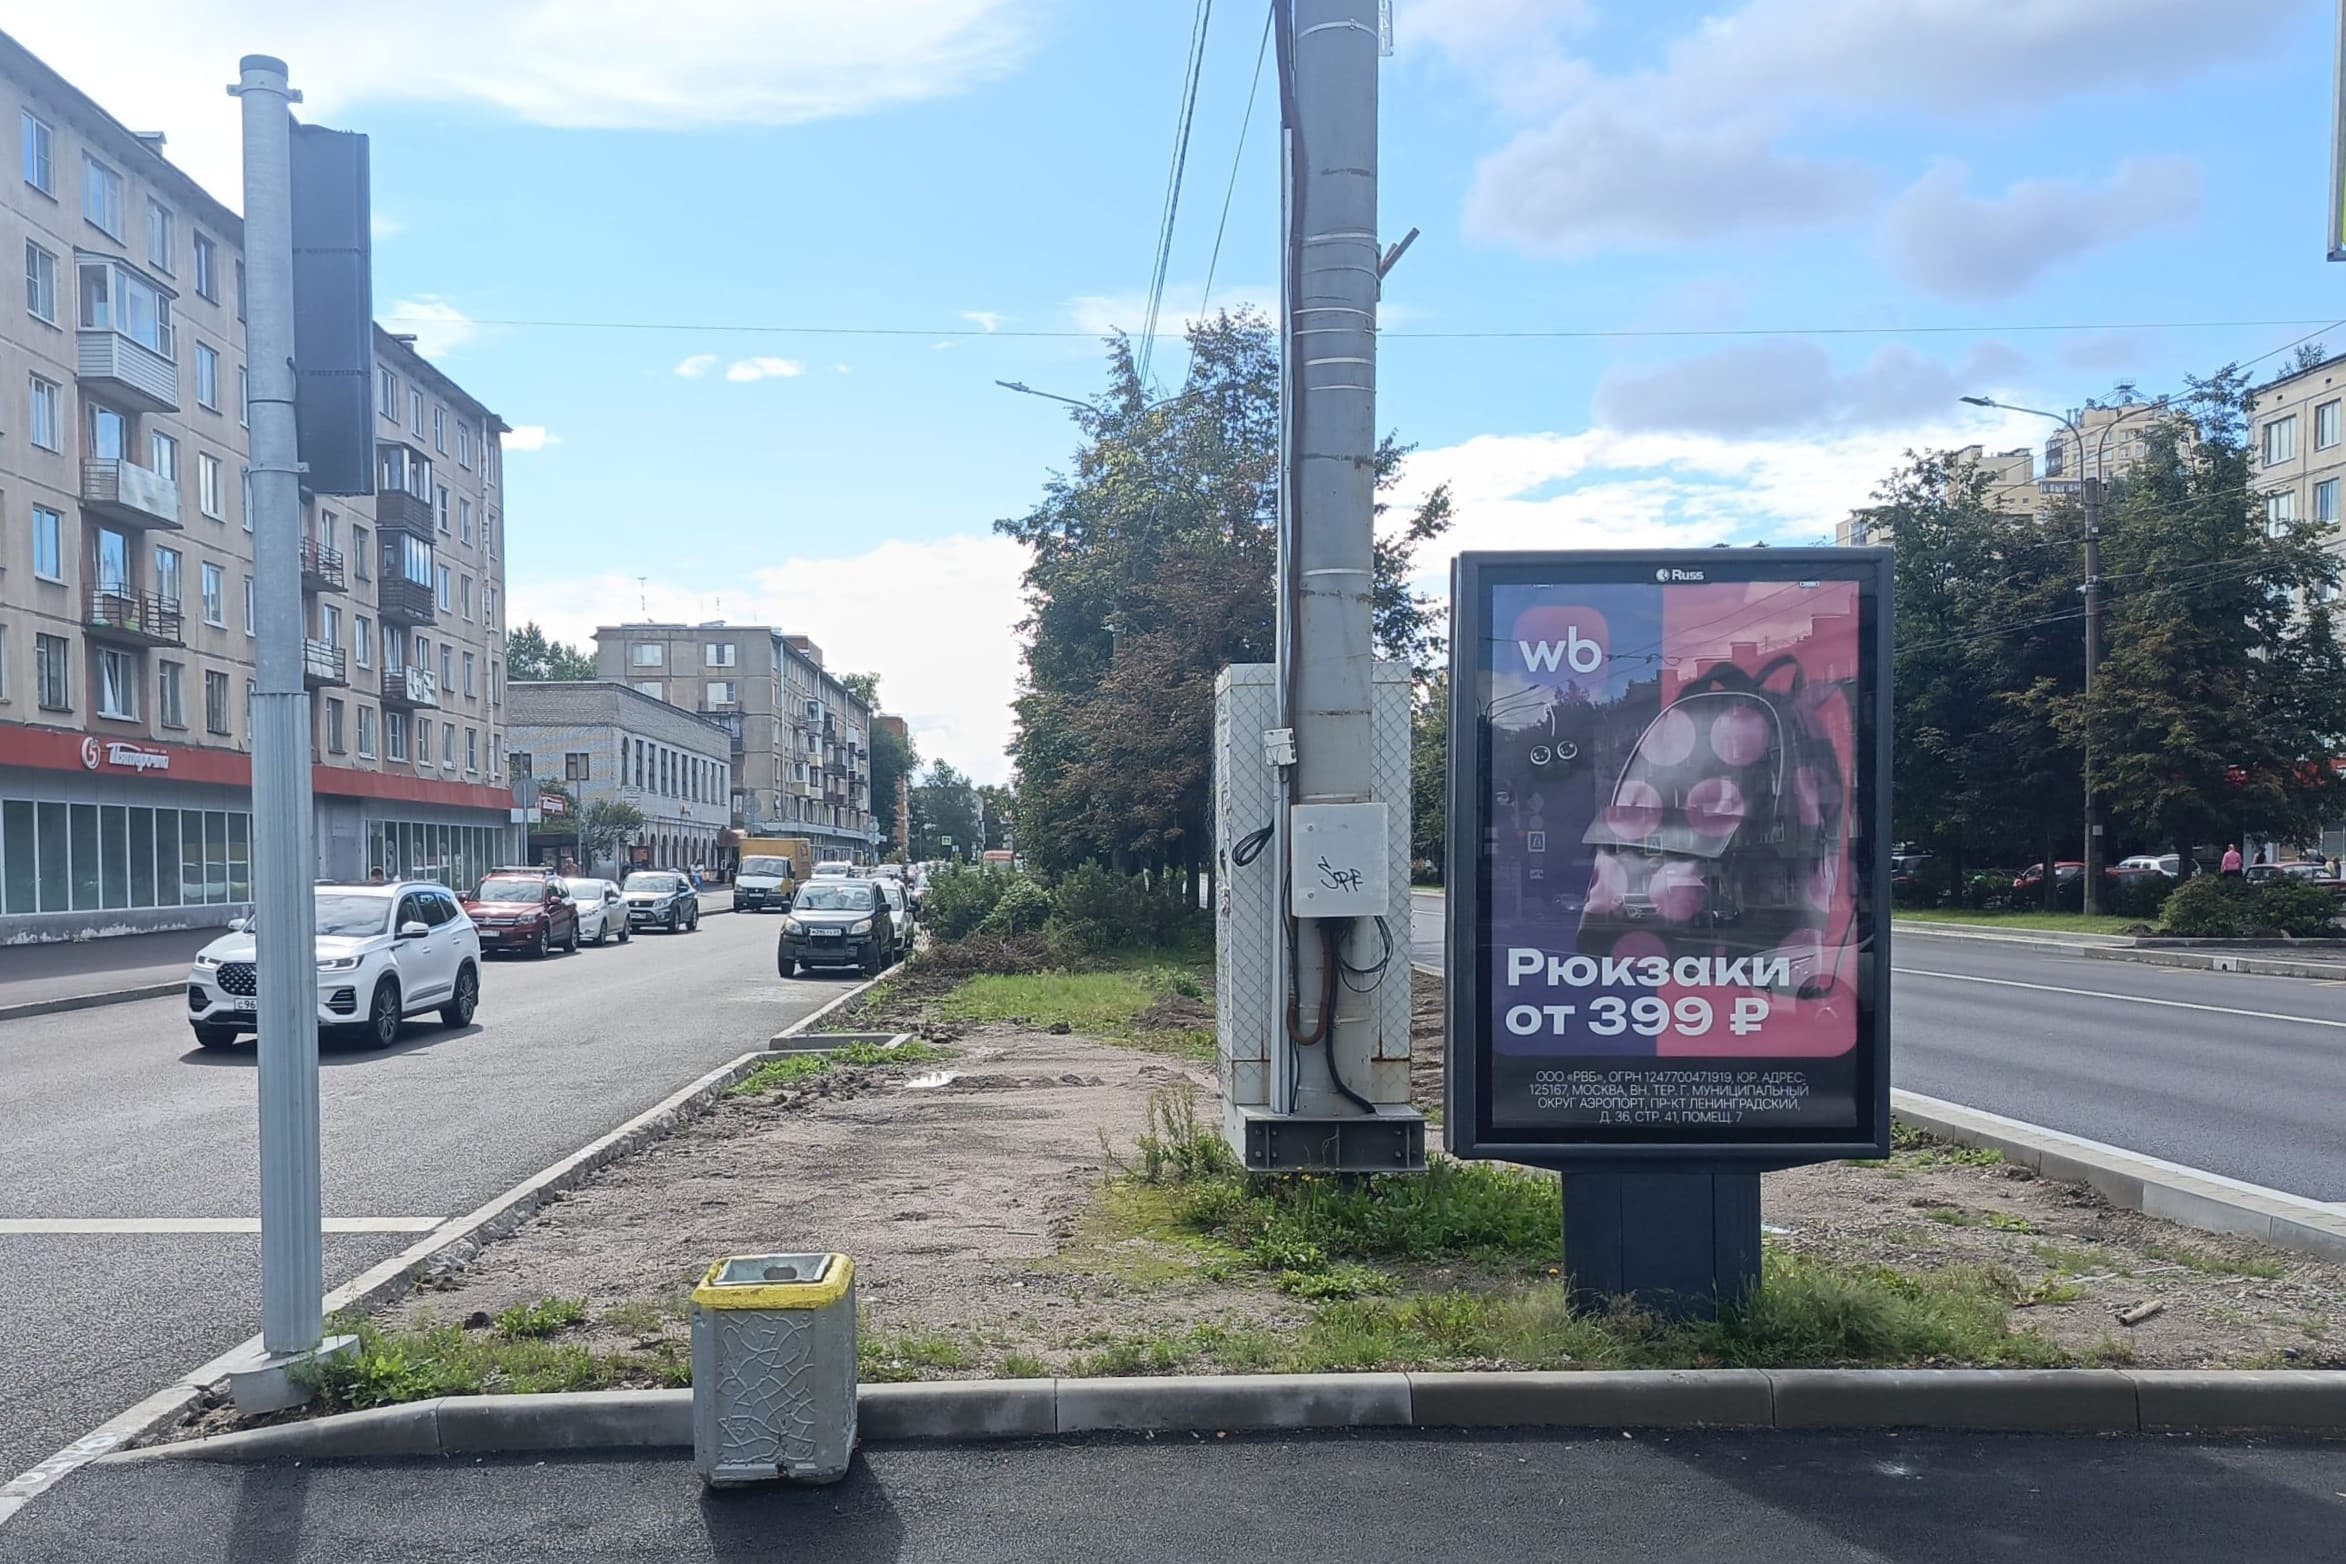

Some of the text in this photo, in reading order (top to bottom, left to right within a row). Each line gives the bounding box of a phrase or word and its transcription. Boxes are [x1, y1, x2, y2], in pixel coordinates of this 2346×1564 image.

[1672, 569, 1704, 581] Russ
[1519, 626, 1602, 673] wb
[1507, 947, 1790, 986] Рюкзаки
[1505, 996, 1769, 1036] от 399 ₽
[1536, 1070, 1565, 1082] ООО
[1608, 1071, 1642, 1083] ОГРН
[1645, 1071, 1734, 1084] 1247700471919,
[1736, 1071, 1760, 1083] ЮР.
[1530, 1083, 1809, 1097] 125167, МОСКВА, ВН. ТЕР. Г. МУНИЦИПАЛЬНЫЙ
[1538, 1096, 1801, 1111] ОКРУГ АЭРОПОРТ, ПР-КТ ЛЕНИНГРАДСКИЙ,
[1615, 1111, 1633, 1124] 36,
[1635, 1111, 1662, 1122] СТР.
[1664, 1111, 1680, 1124] 41,
[1736, 1112, 1743, 1122] 7
